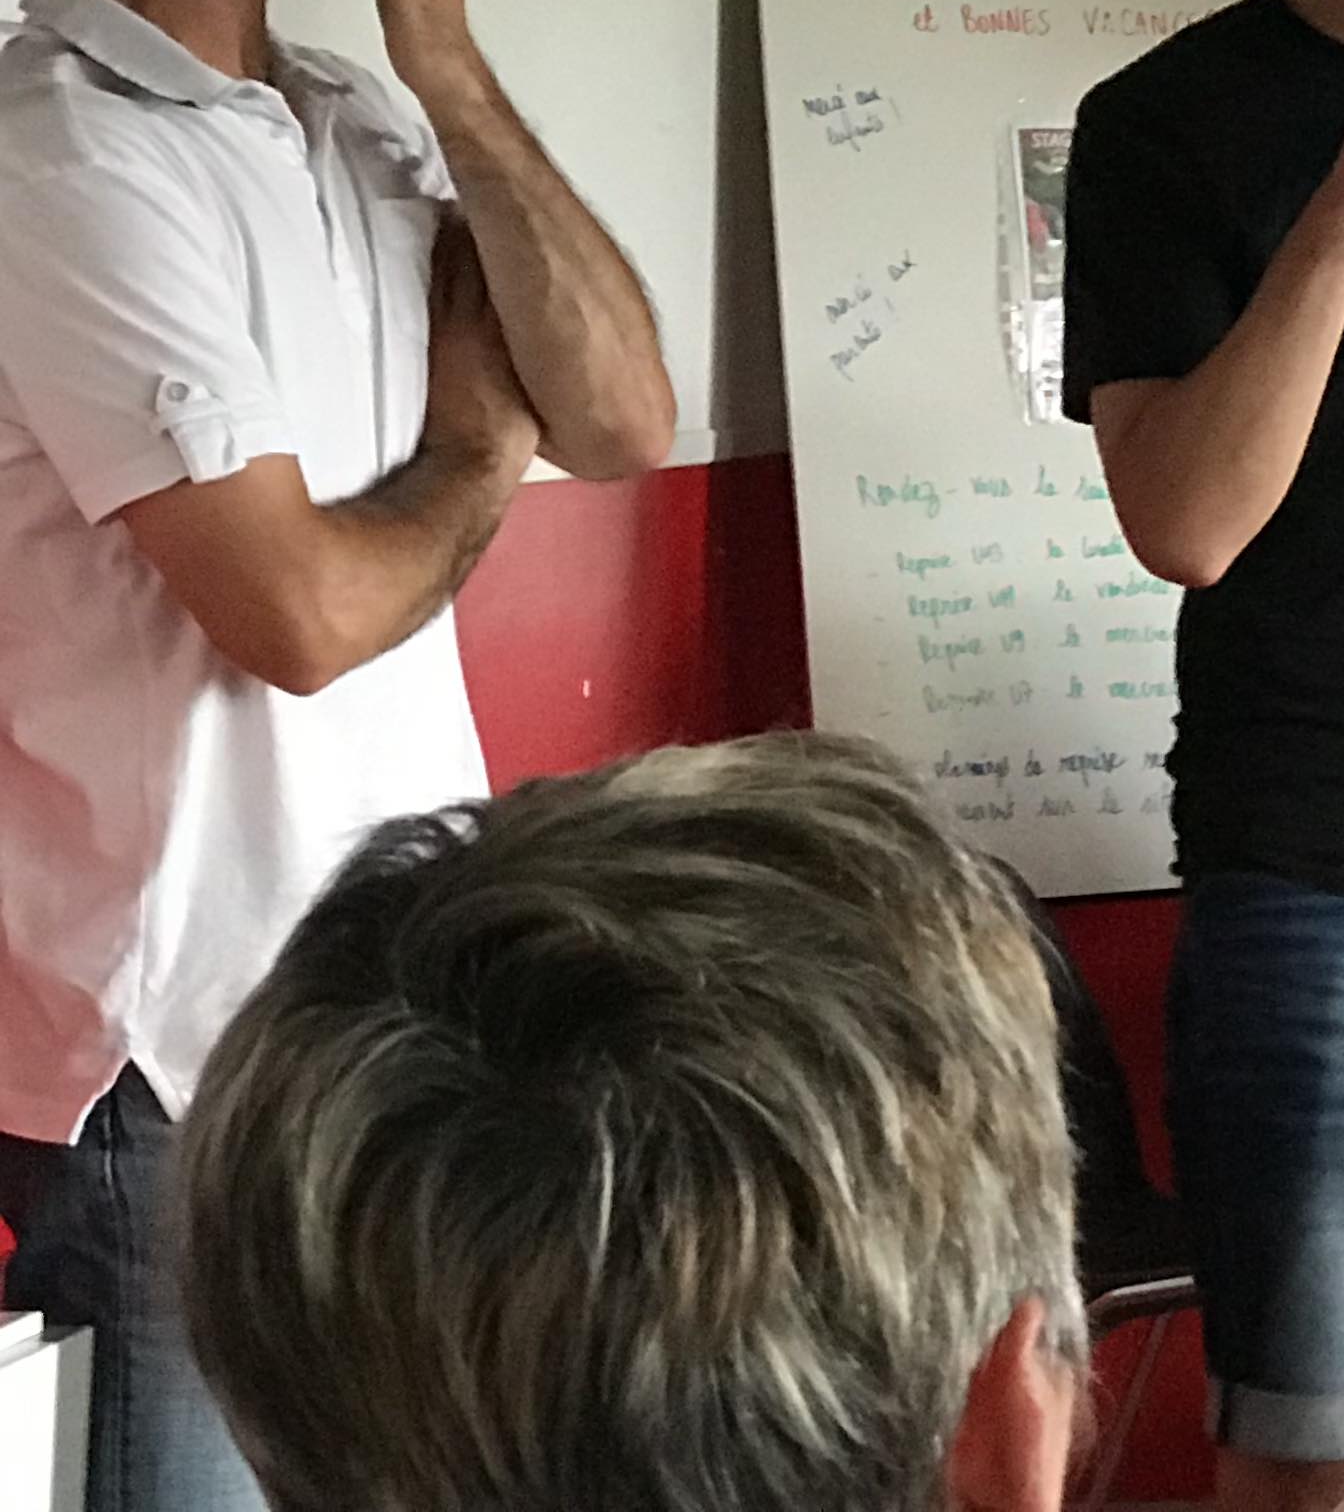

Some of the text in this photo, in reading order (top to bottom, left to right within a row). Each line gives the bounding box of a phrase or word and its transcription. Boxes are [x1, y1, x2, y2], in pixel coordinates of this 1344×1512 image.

[913, 4, 939, 33] et
[961, 4, 1051, 36] BONNES
[1031, 131, 1072, 148] STAG
